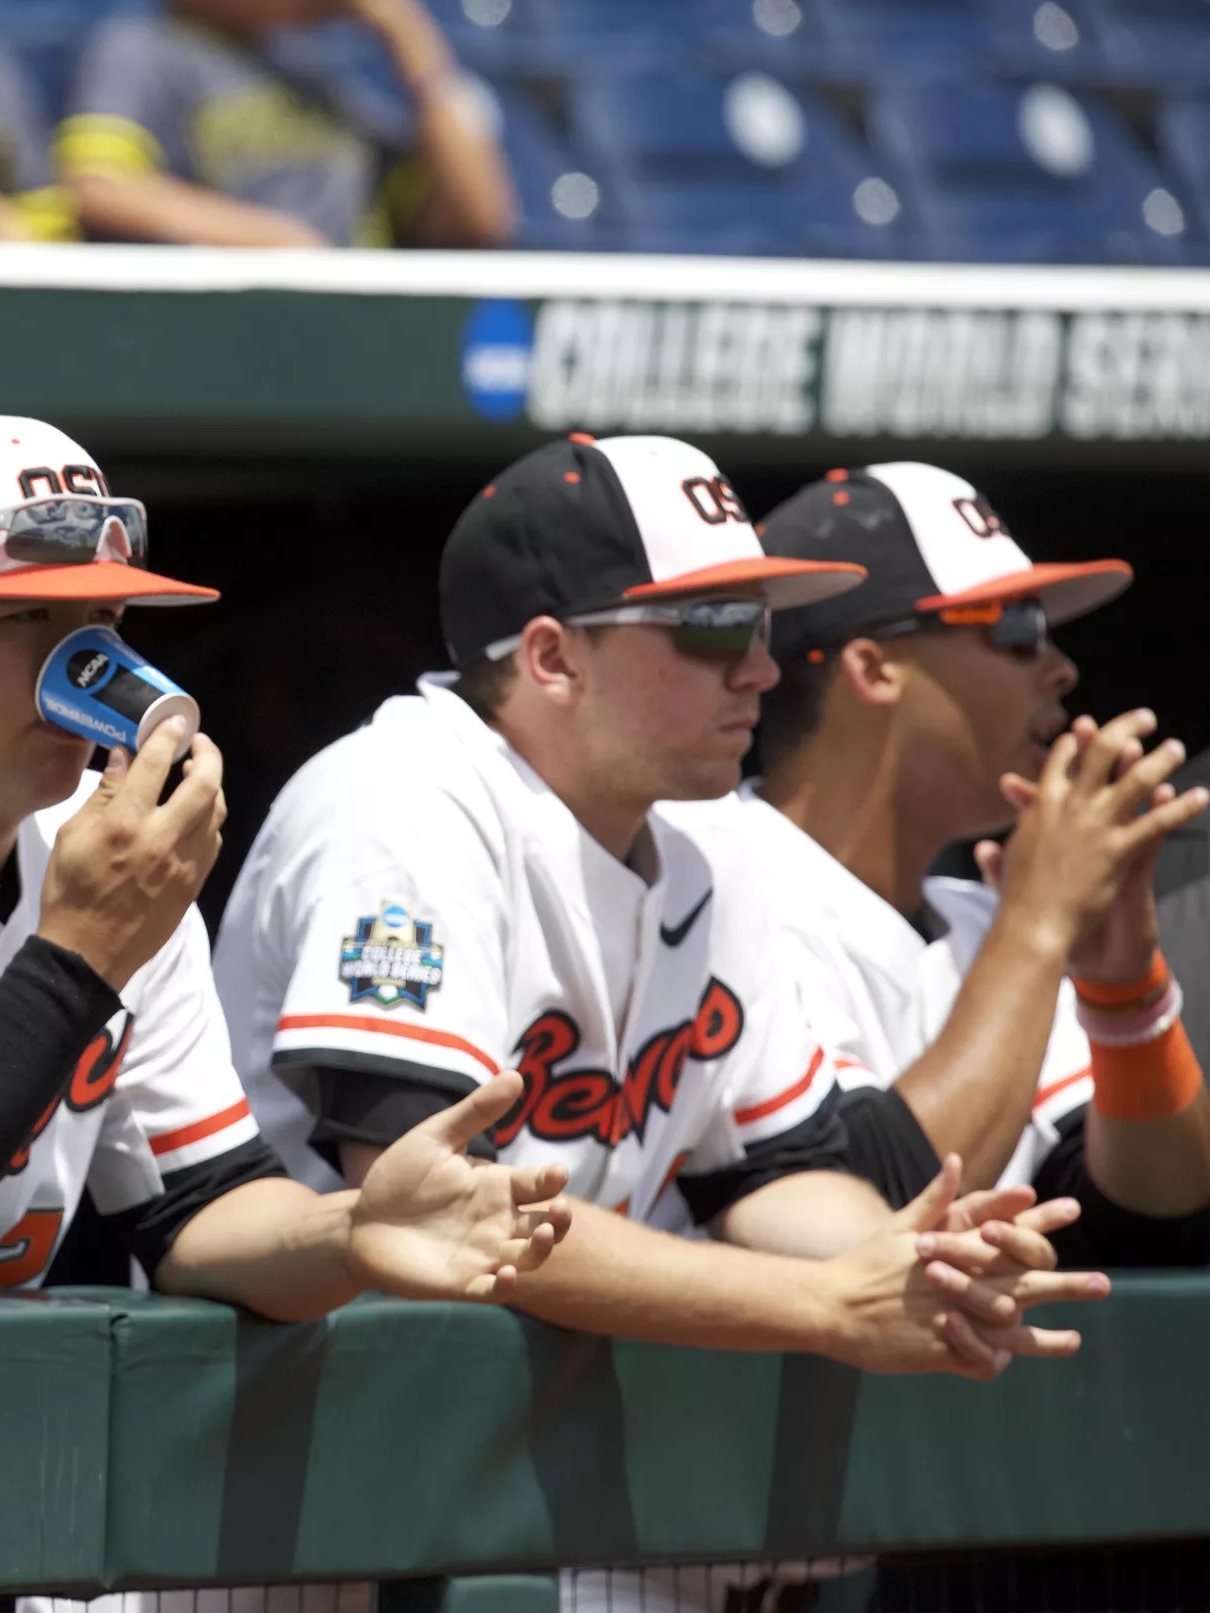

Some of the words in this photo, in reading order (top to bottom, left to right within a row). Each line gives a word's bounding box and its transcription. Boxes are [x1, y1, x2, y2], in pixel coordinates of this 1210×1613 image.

[526, 300, 820, 430] COLLEGE
[821, 307, 1060, 437] WORLD
[76, 653, 109, 687] NCAA
